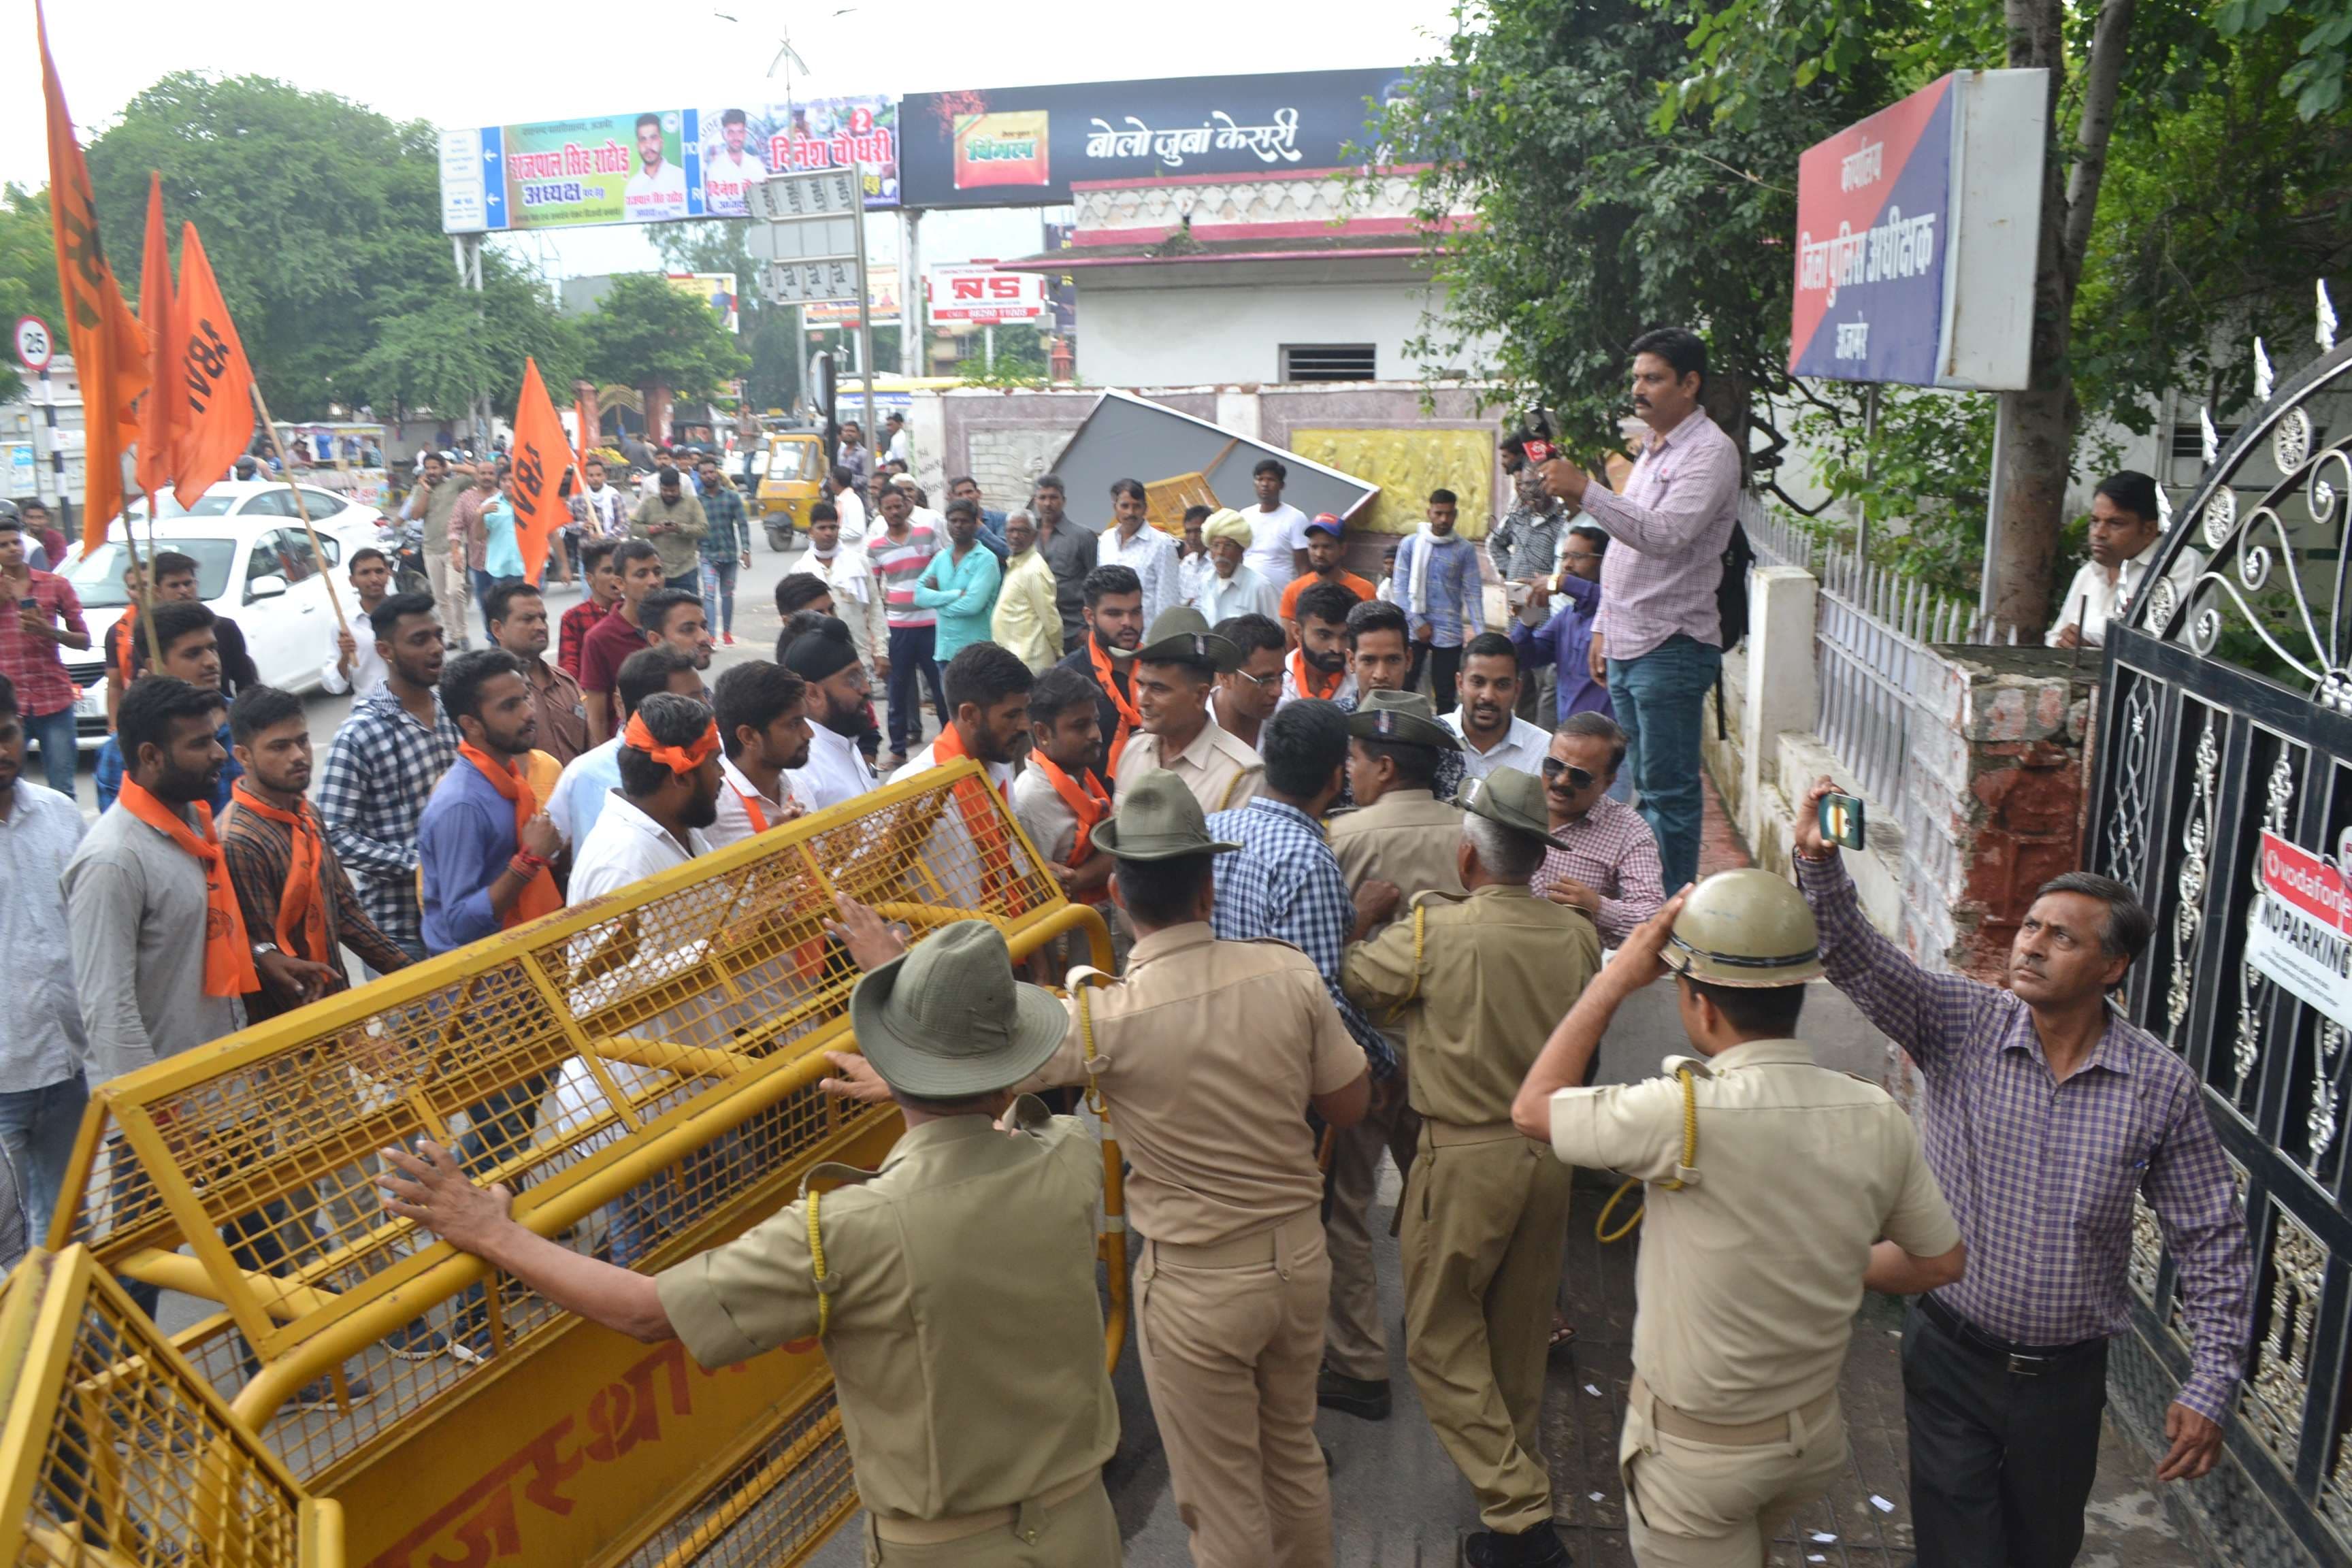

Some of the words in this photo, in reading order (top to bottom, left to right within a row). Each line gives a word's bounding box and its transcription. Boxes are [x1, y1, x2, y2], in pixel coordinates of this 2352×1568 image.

[855, 112, 868, 132] 2
[1086, 116, 1154, 157] बोलो
[1212, 108, 1303, 163] केसरी
[564, 142, 591, 176] सिंह
[1840, 135, 1884, 193] कार्यालय
[523, 182, 583, 205] अध्यक्ष
[1799, 231, 1829, 291] जिला
[1826, 220, 1867, 308] पुलिस
[1865, 205, 1936, 282] अधीक्षक
[951, 276, 1021, 299] NS
[23, 333, 46, 354] 25
[1835, 310, 1870, 361] अजमेर
[2280, 860, 2352, 919] vodafone
